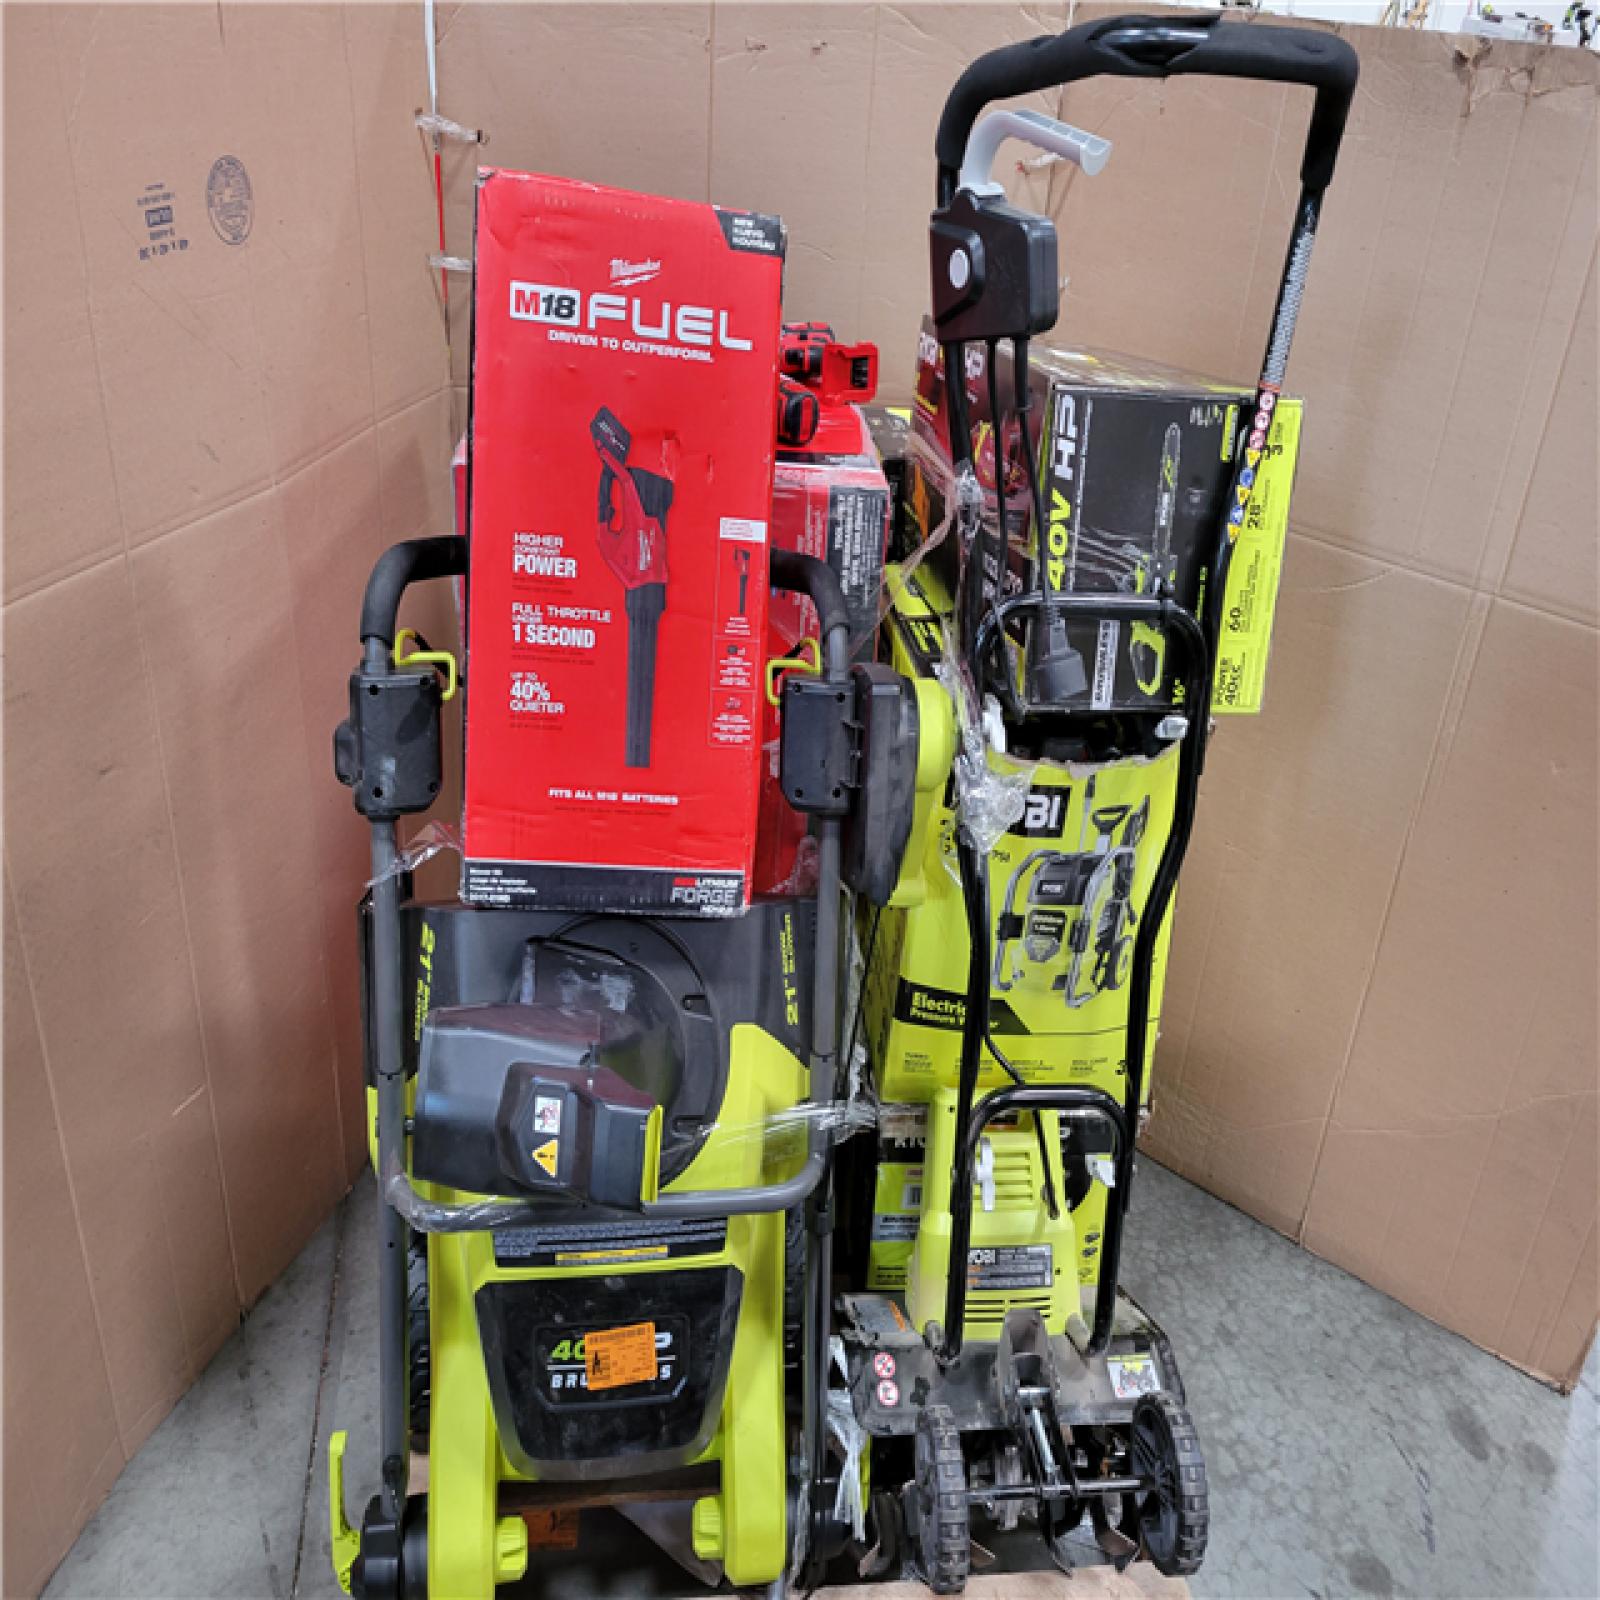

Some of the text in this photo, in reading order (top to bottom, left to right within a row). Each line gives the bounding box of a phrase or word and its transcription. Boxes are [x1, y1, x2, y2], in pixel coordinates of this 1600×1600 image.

[513, 288, 752, 351] M18 FUEL
[547, 329, 599, 348] DRIVEN
[601, 336, 620, 351] TO
[1047, 394, 1078, 591] 40V HP
[513, 531, 564, 549] HIGHER
[513, 554, 577, 578] POWER
[512, 602, 612, 623] FULL THROTTLE
[512, 624, 596, 649] 1 SECOND
[510, 680, 551, 700] 40%
[509, 699, 565, 714] QUIETER
[548, 787, 571, 798] FITS
[574, 789, 593, 800] ALL
[621, 792, 679, 806] BATTERIES
[670, 887, 736, 905] FORGE
[551, 1339, 586, 1361] 40
